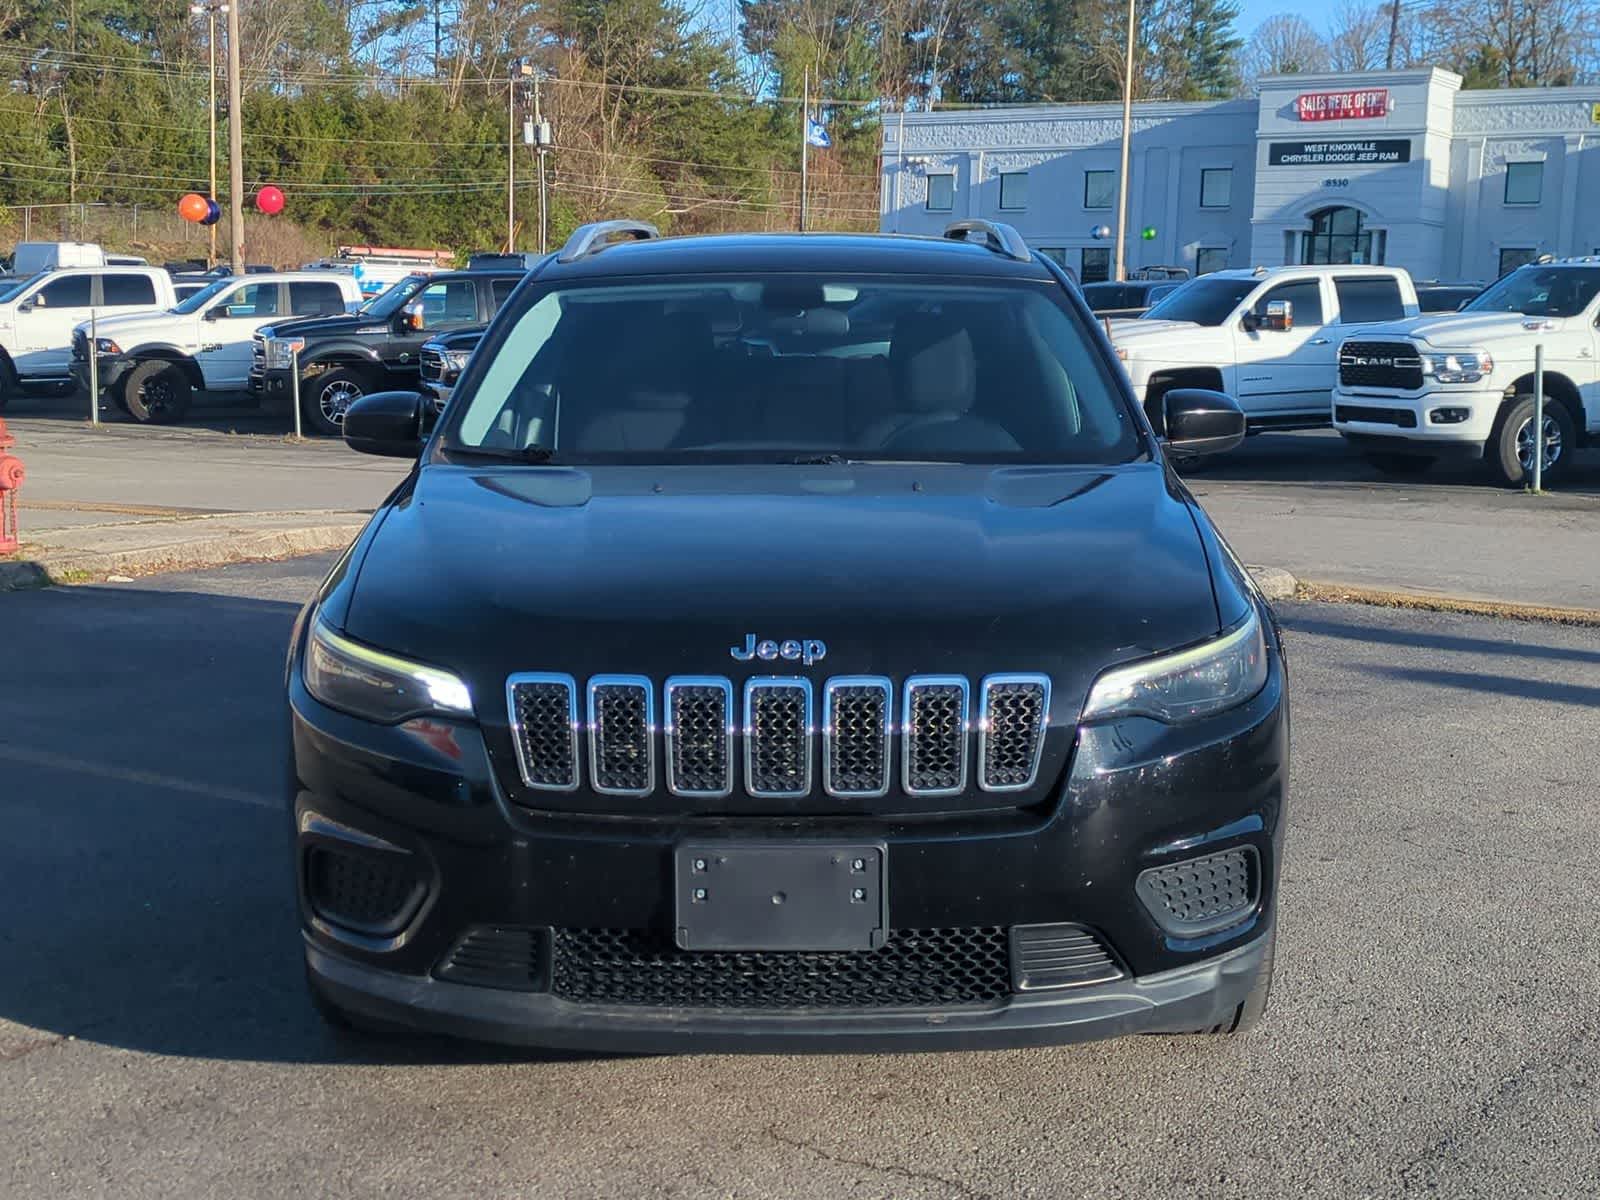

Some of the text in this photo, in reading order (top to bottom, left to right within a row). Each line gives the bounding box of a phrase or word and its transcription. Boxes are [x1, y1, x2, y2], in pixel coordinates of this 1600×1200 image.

[1304, 143, 1376, 152] WEST KNOXVILLE
[1281, 151, 1399, 163] CHRYSLER DODGE JEEP RAM
[1357, 357, 1391, 366] RAM
[730, 633, 826, 666] Jeep
